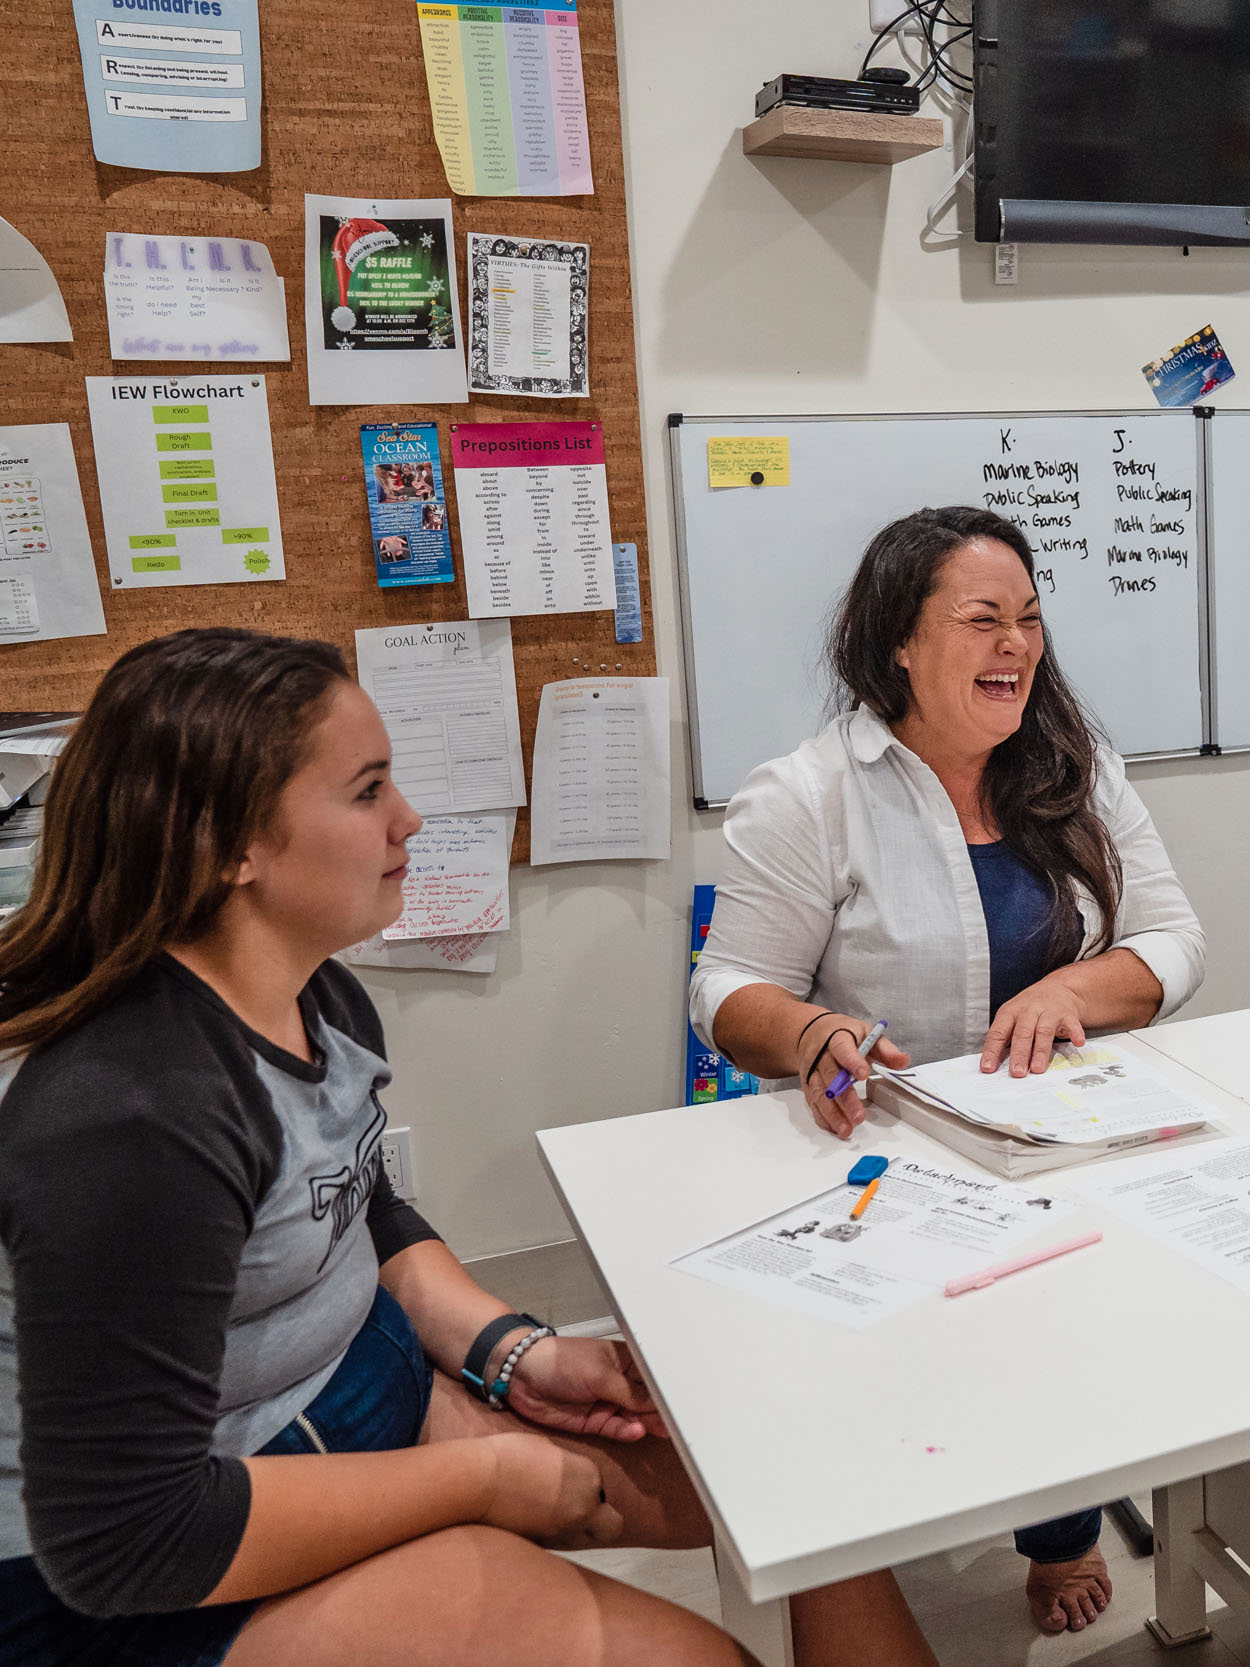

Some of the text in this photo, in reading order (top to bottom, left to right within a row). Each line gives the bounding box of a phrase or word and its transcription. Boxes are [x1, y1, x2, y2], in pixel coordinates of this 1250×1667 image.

[101, 23, 115, 38] A
[106, 59, 119, 74] R
[110, 96, 122, 110] T
[365, 257, 413, 268] $5 RAFFLE
[152, 310, 171, 318] Help?
[112, 384, 244, 400] IEW Flowchart
[377, 430, 422, 443] Sea Star
[373, 441, 428, 454] OCEAN
[461, 437, 593, 455] Prepositions List
[372, 452, 431, 463] CLASSROOM
[983, 459, 1079, 484] Marine Biology
[1112, 459, 1156, 481] Pottery
[1027, 484, 1080, 510] Speaking
[1117, 482, 1192, 512] Public Speaking
[1033, 513, 1072, 528] Games
[1114, 513, 1185, 535] Math Games
[1040, 537, 1089, 560] Writing
[1107, 545, 1189, 569] Marine Biology
[1108, 575, 1157, 597] Drones
[384, 632, 466, 649] GOAL ACTION
